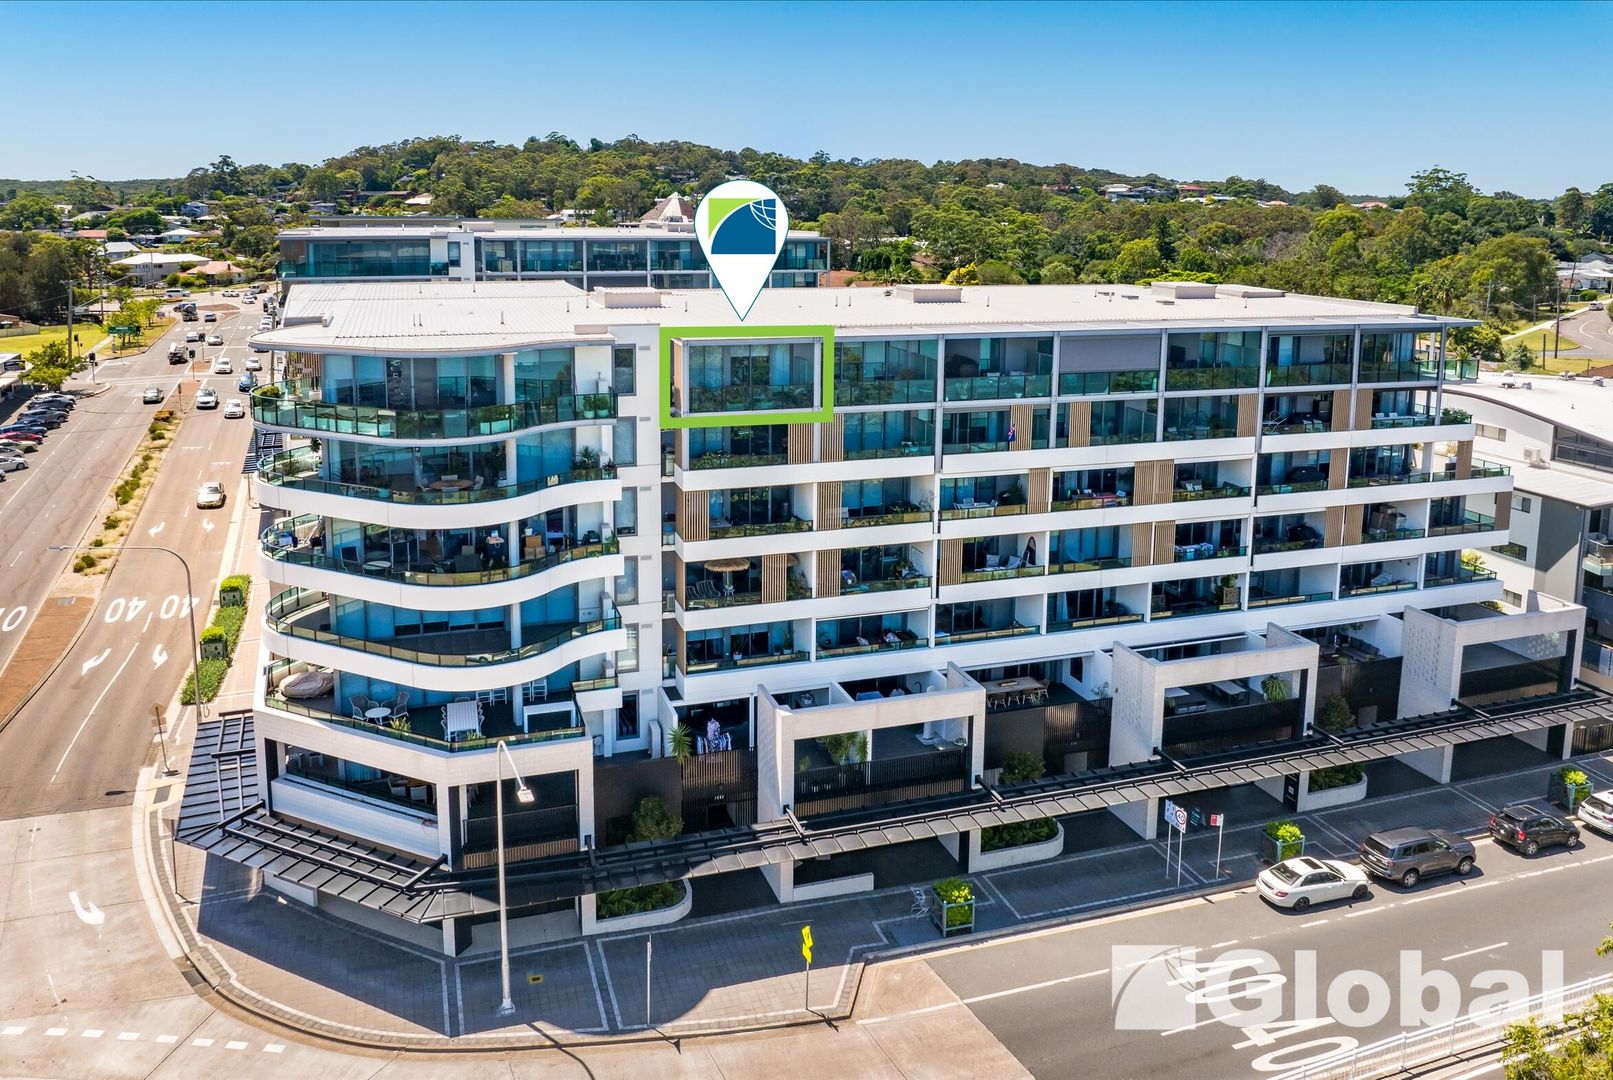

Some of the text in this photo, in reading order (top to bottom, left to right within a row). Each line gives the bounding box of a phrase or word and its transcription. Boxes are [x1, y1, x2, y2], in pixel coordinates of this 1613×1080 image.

[0, 605, 28, 632] 0
[104, 596, 147, 623] 40
[159, 594, 200, 619] 40
